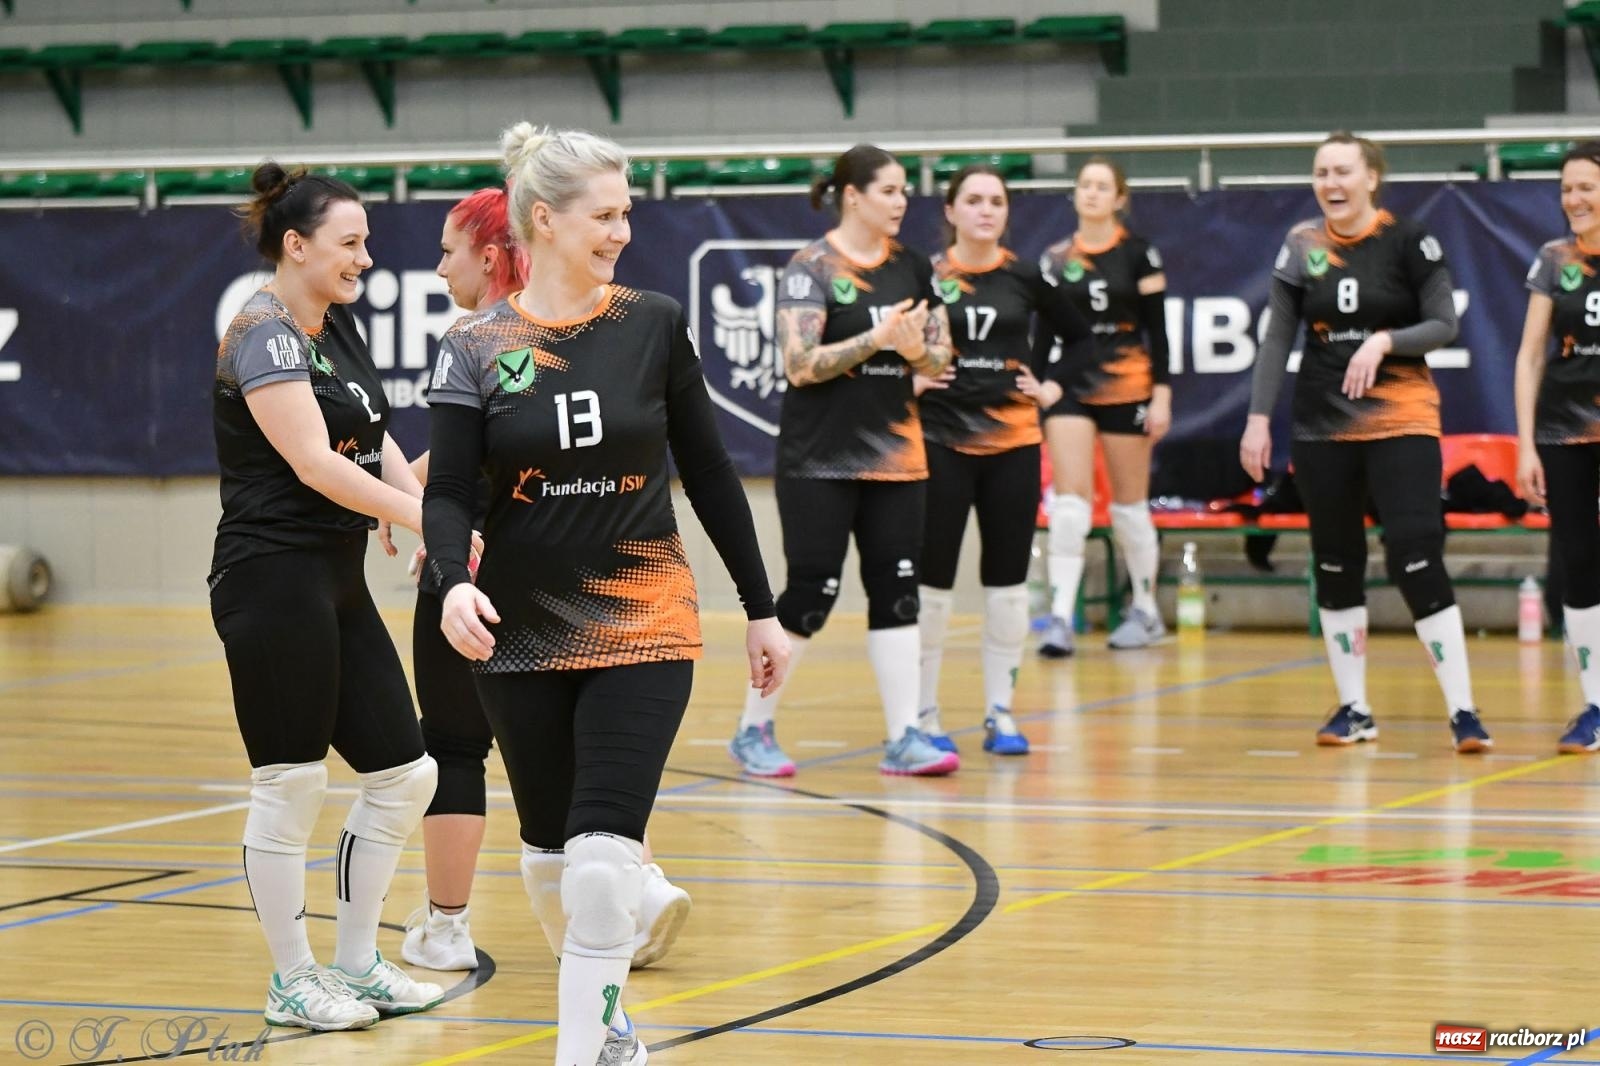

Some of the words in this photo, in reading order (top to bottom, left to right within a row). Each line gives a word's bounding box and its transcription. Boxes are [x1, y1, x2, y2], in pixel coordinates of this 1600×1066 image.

[1088, 279, 1109, 312] 5
[1337, 277, 1359, 314] 8
[1584, 291, 1600, 327] 9
[964, 306, 997, 341] 17
[346, 382, 381, 423] 2
[554, 389, 603, 450] 13
[541, 476, 617, 498] Fundacja
[618, 475, 647, 495] JSW
